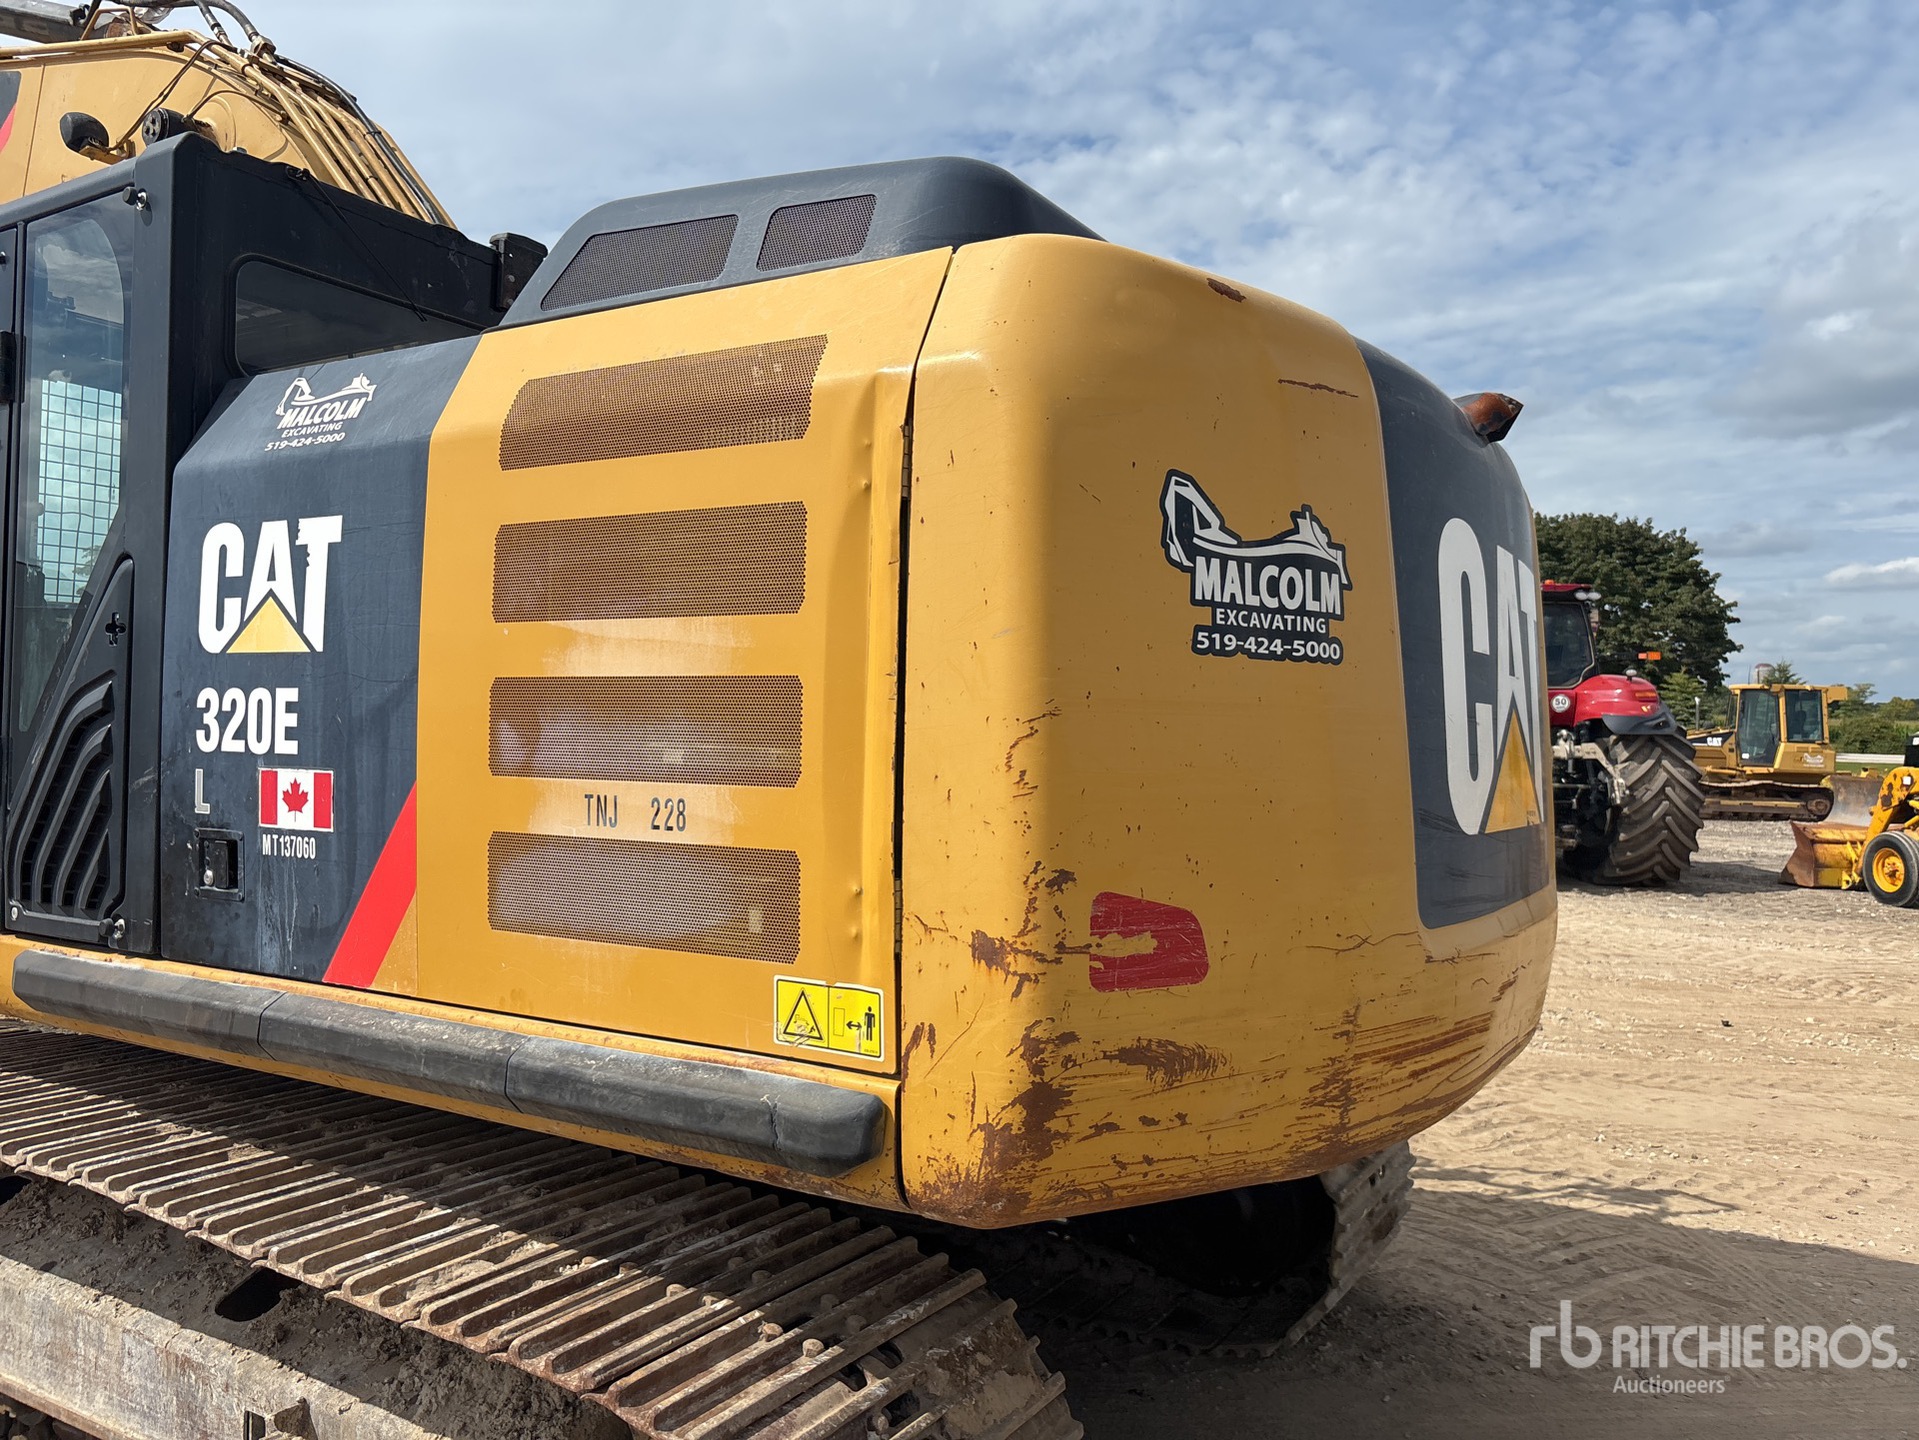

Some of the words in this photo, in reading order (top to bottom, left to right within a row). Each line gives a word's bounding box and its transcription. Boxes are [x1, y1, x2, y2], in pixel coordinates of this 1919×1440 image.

[276, 397, 368, 430] MALCOLM
[281, 421, 343, 438] EXCAVATING
[264, 432, 346, 452] 519-424-5000
[198, 515, 343, 654] CAT
[1194, 555, 1342, 615] MALCOLM
[1216, 608, 1327, 634] EXCAVATING
[1196, 631, 1341, 660] 519-424-5000
[1438, 517, 1544, 835] CAT
[196, 687, 299, 755] 320E
[194, 768, 211, 815] L
[584, 793, 619, 829] TNJ
[650, 797, 687, 832] 228
